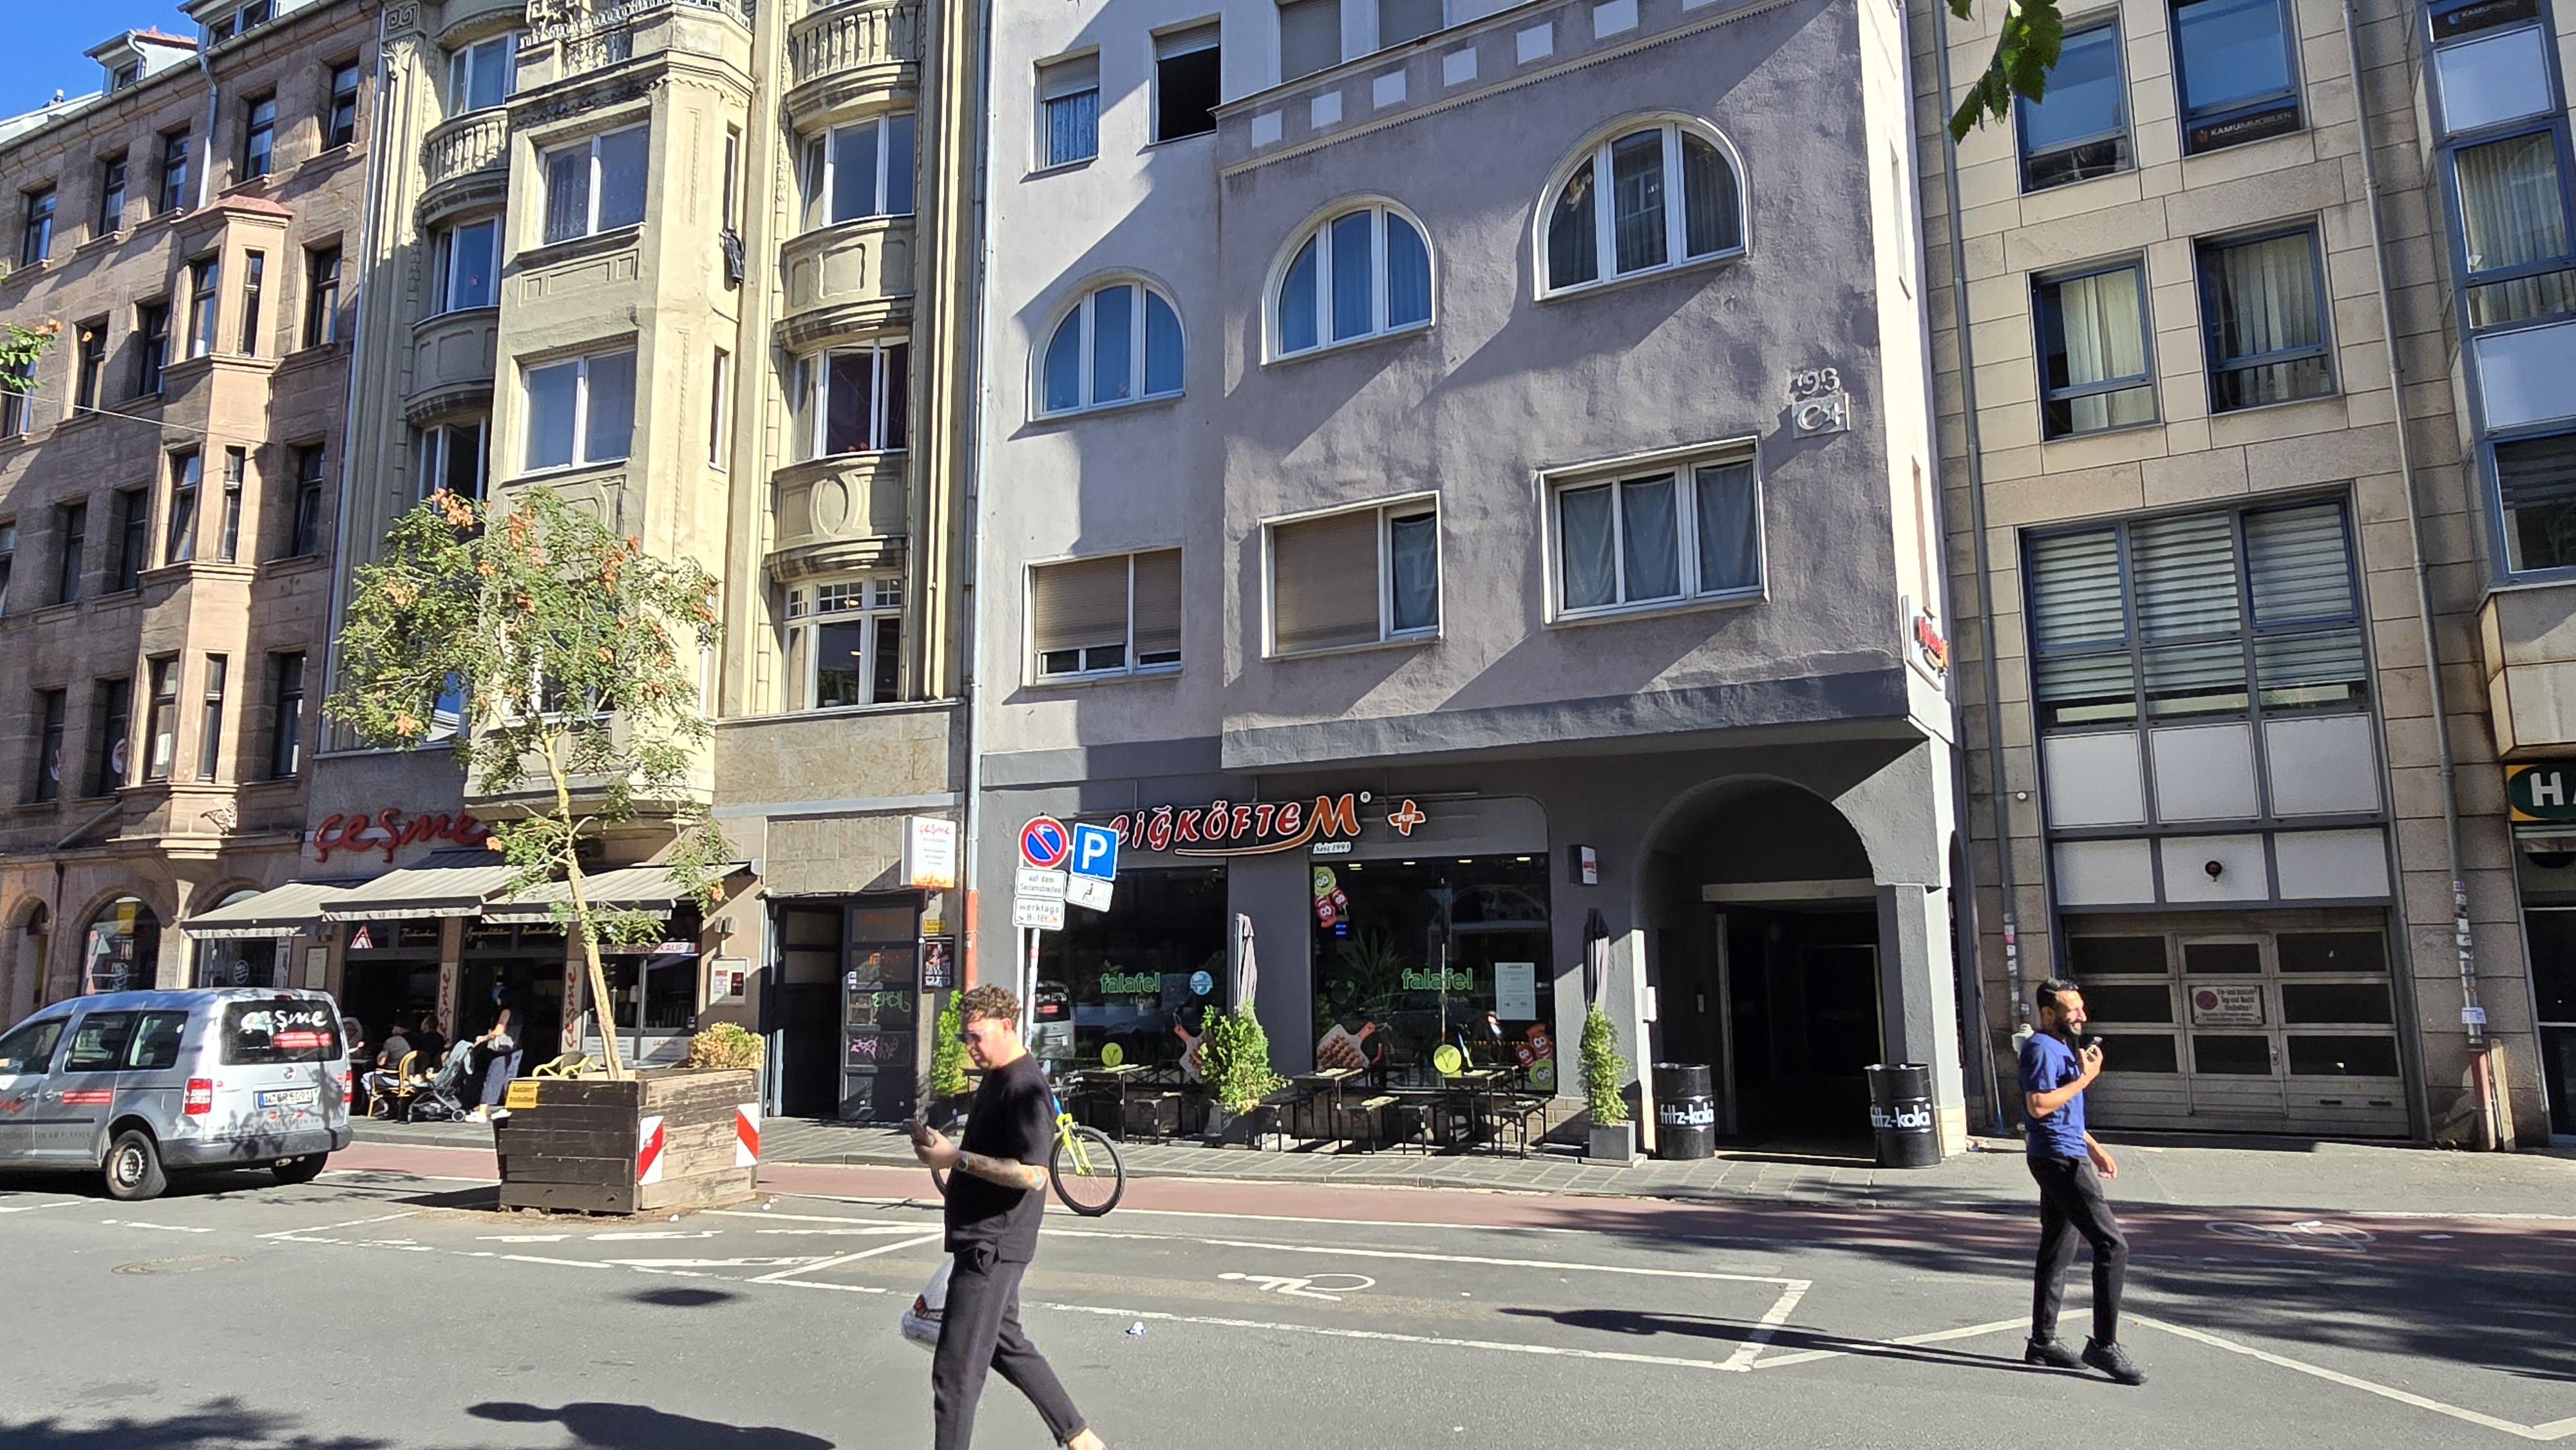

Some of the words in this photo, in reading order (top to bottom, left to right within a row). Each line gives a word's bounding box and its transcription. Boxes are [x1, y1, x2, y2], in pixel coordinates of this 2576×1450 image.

[2530, 772, 2576, 806] H
[1082, 832, 1108, 869] P
[1100, 972, 1160, 993] falafel
[1401, 968, 1473, 990] falafel
